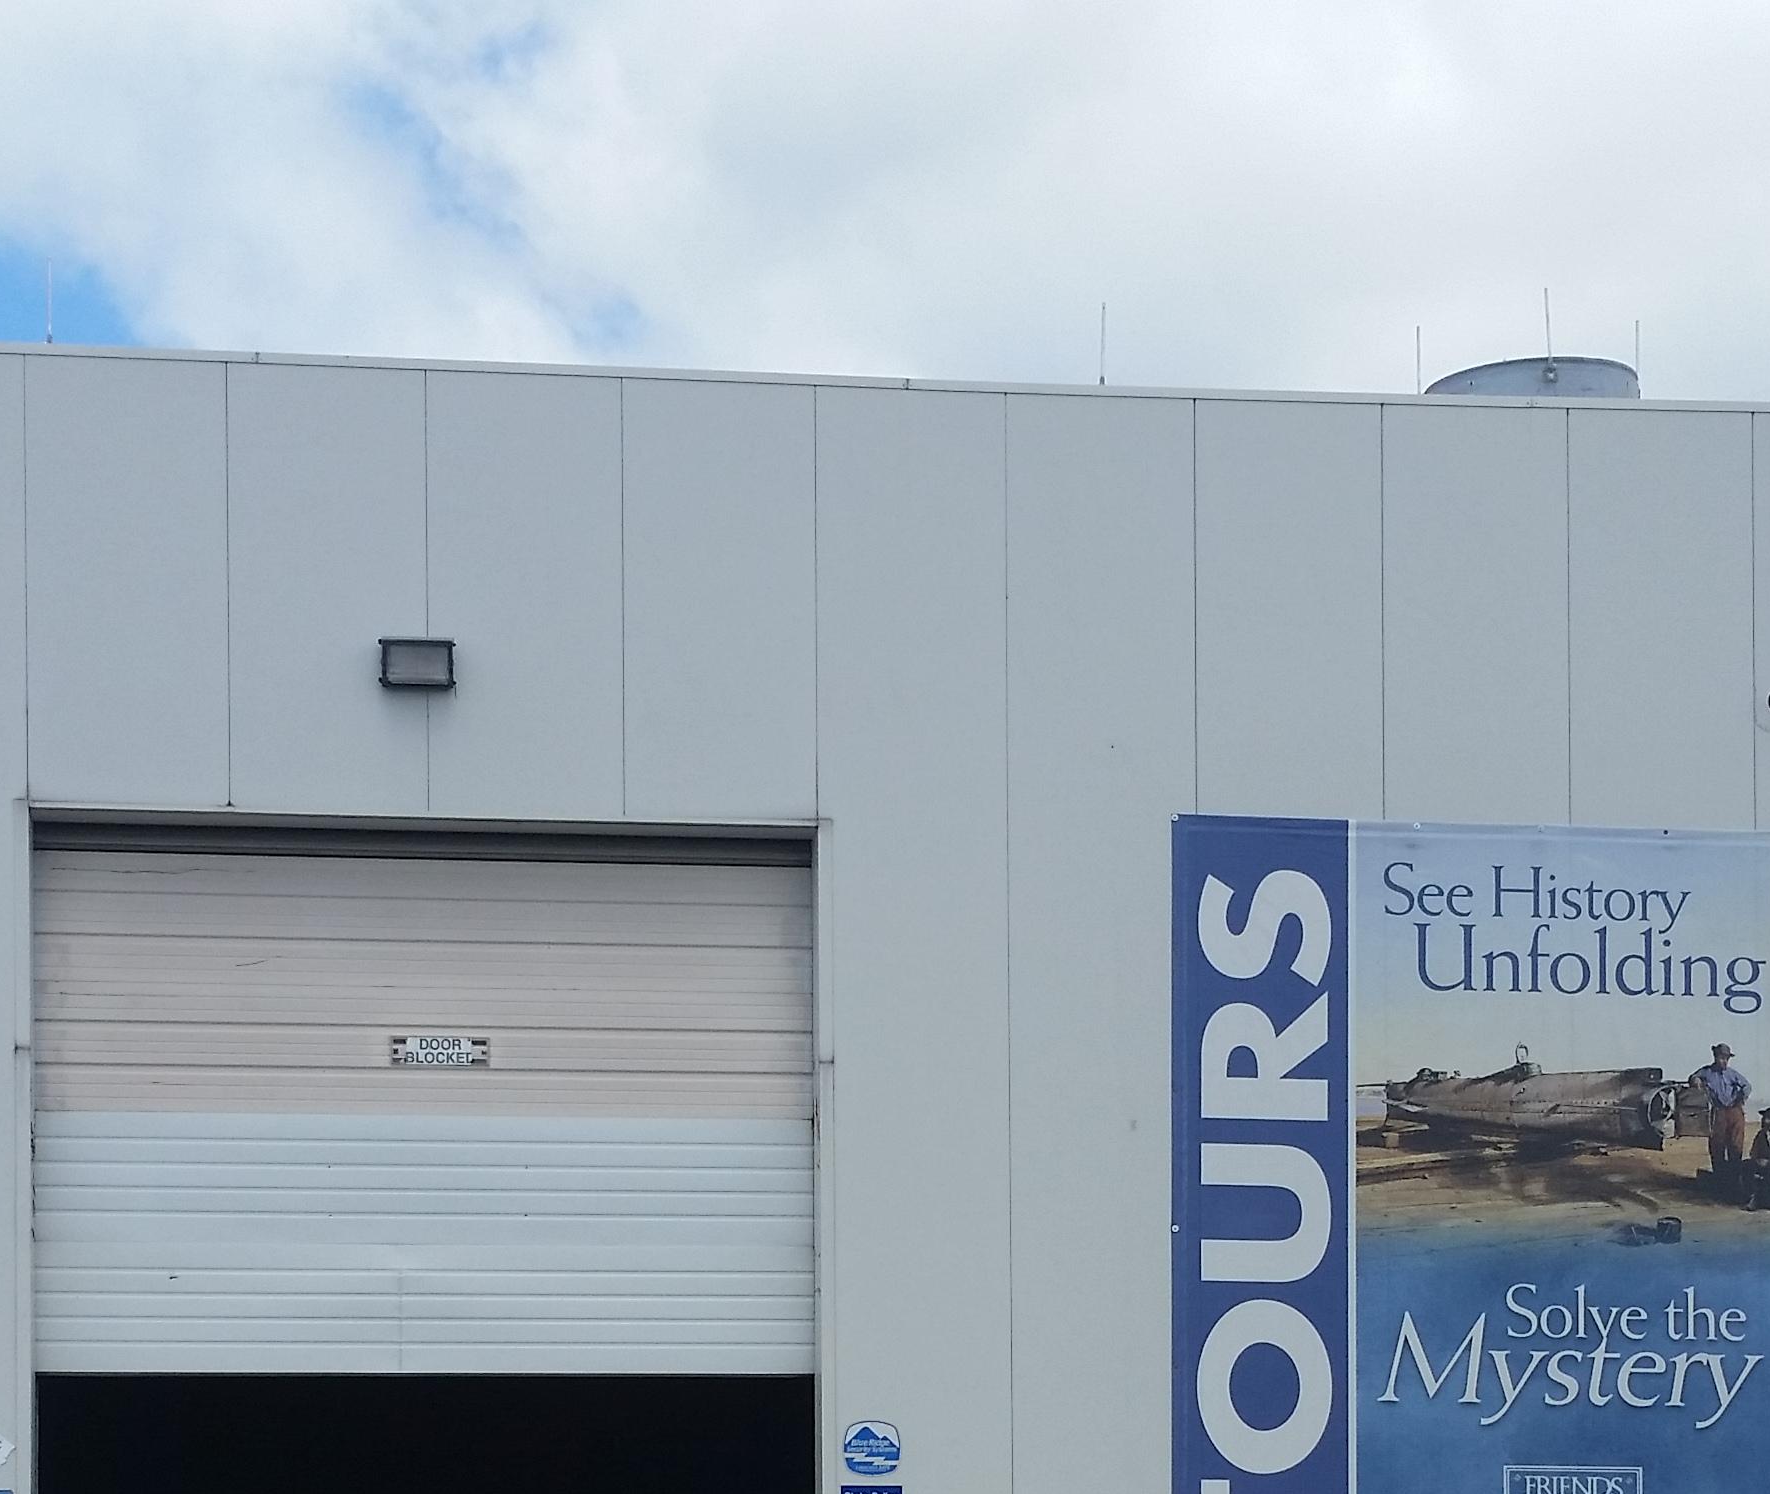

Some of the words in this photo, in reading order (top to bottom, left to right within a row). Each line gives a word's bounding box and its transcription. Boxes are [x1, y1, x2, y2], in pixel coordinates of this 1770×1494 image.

[1382, 861, 1474, 917] See
[1491, 864, 1692, 934] History
[1413, 922, 1767, 1014] Unfolding
[419, 1038, 462, 1051] DOOR
[1504, 1282, 1648, 1342] Solve
[1664, 1285, 1748, 1343] the
[1376, 1310, 1765, 1430] Mystery
